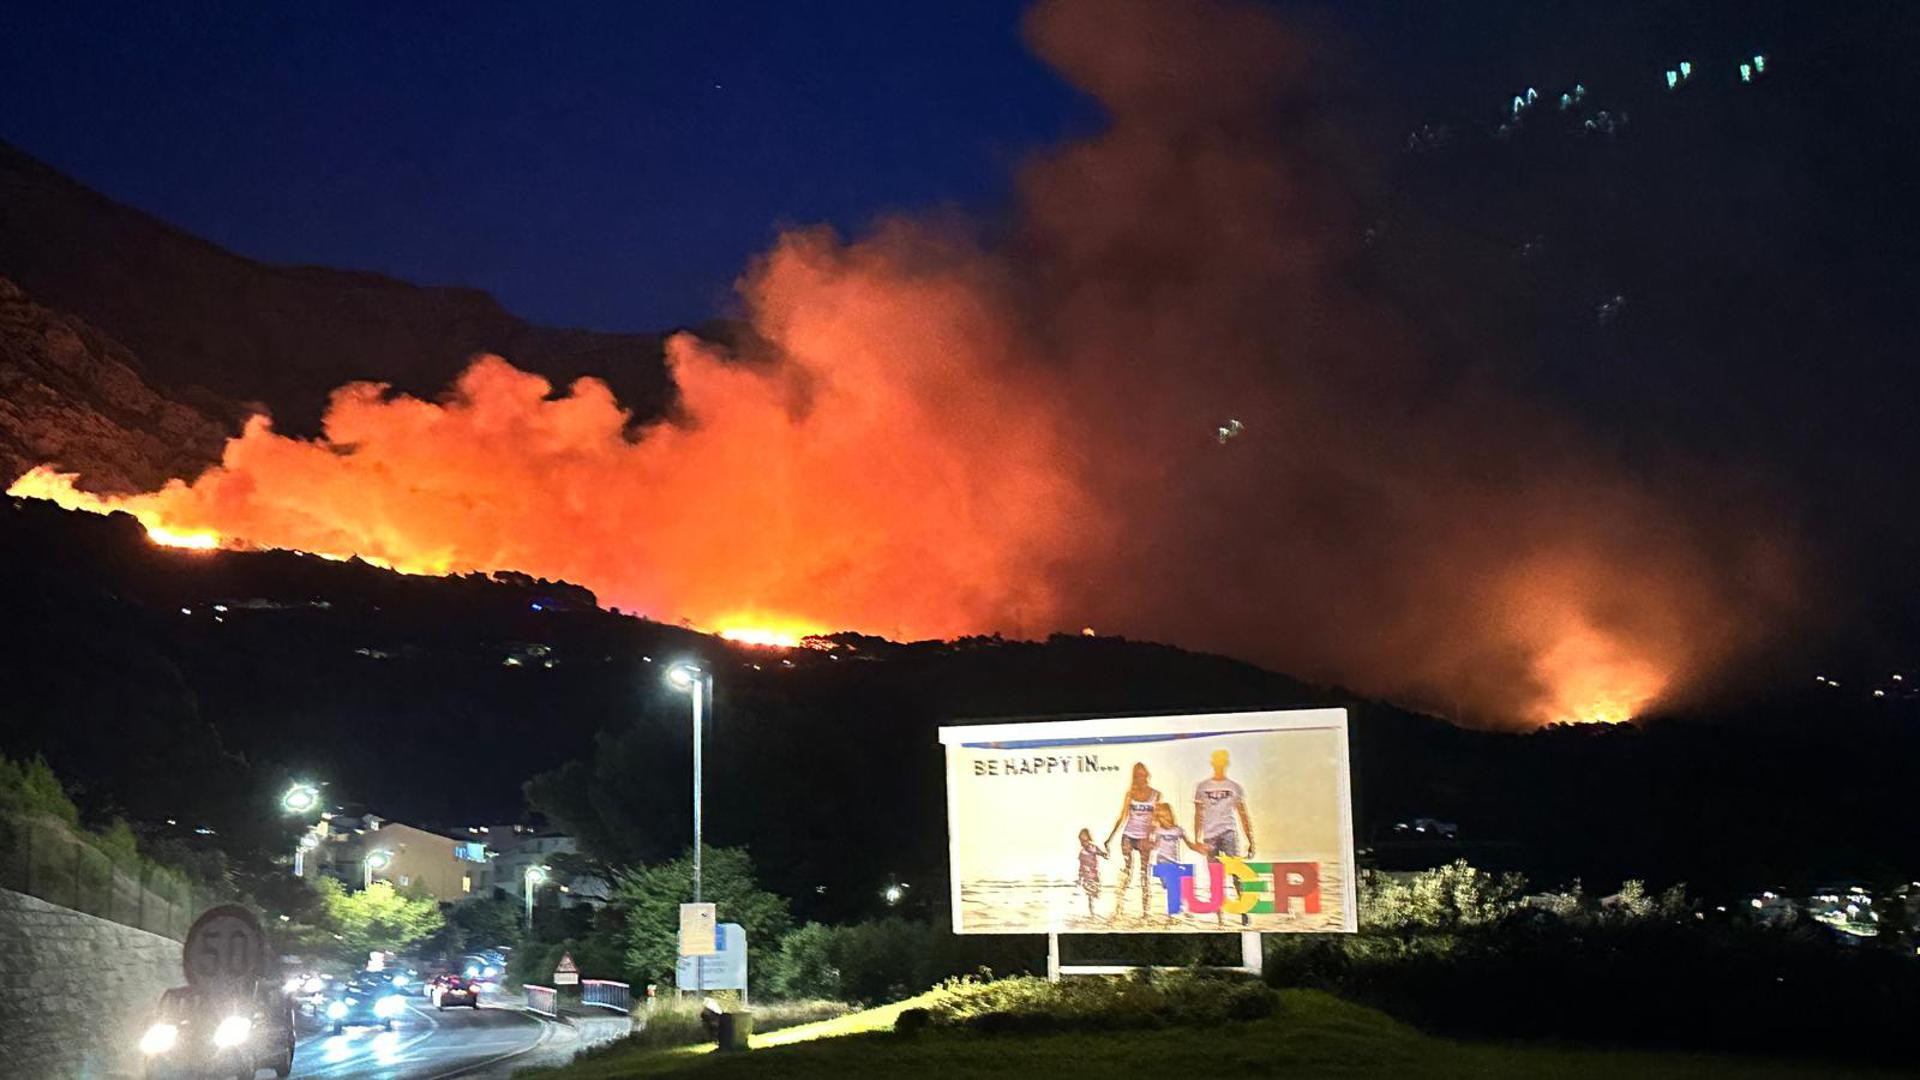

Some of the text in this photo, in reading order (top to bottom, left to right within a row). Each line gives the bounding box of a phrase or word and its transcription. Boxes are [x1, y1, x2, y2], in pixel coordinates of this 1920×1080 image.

[974, 759, 998, 775] BE
[1003, 755, 1070, 775] HAPPY
[200, 929, 248, 975] 50
